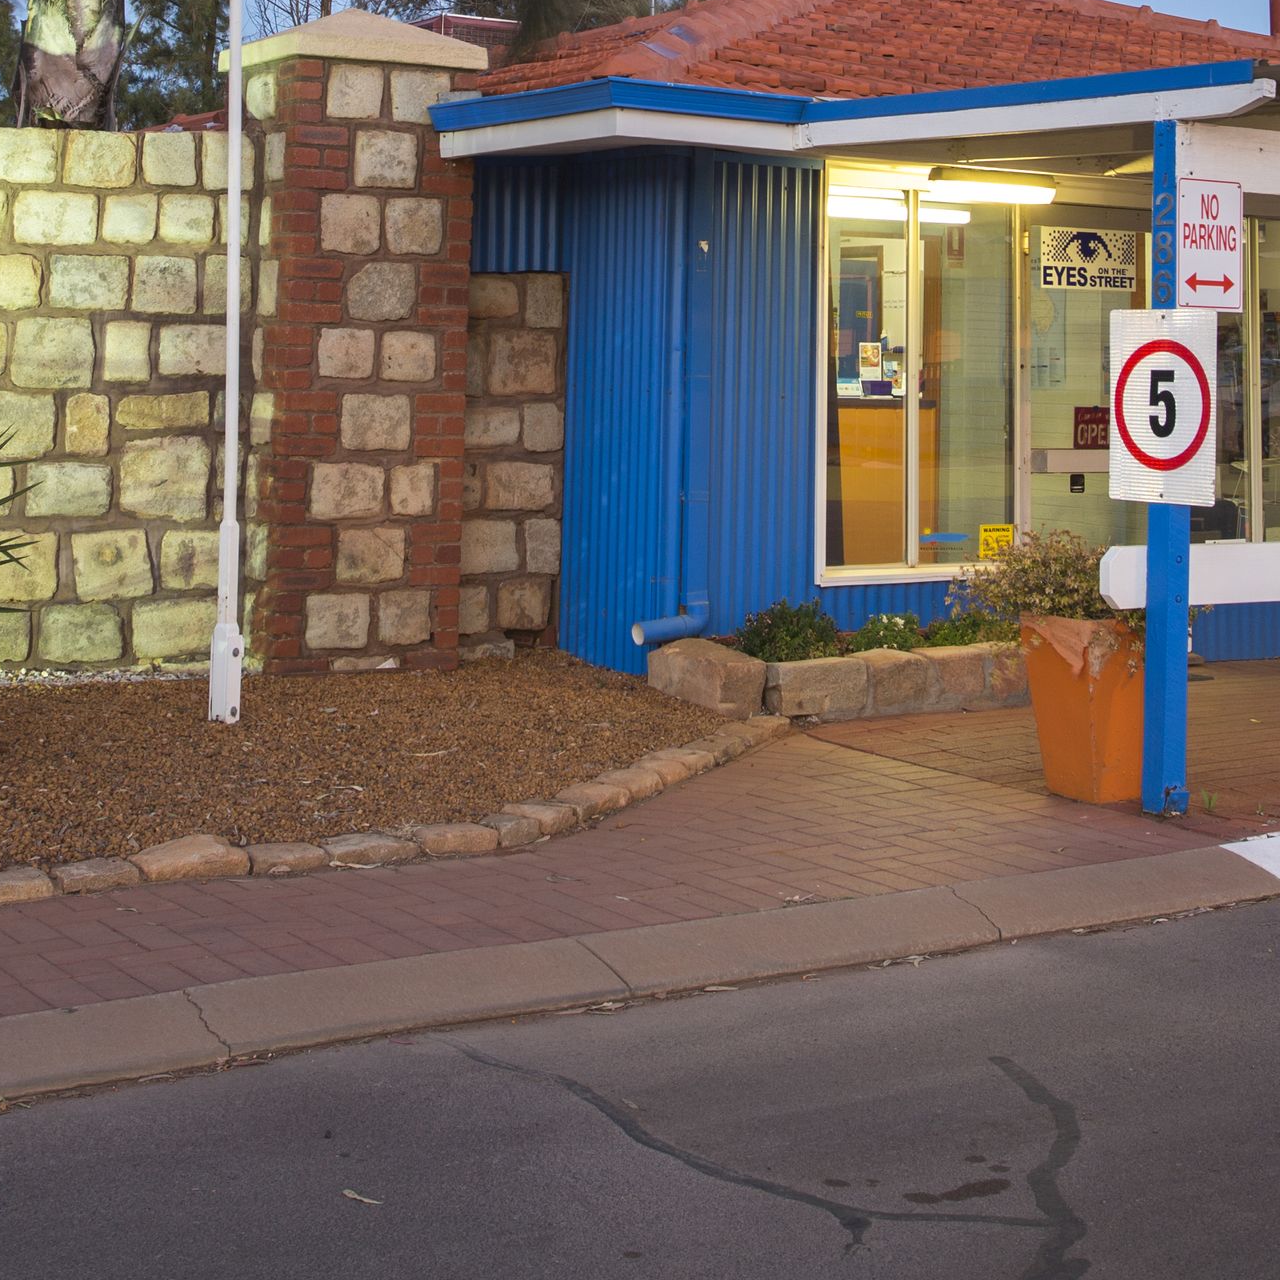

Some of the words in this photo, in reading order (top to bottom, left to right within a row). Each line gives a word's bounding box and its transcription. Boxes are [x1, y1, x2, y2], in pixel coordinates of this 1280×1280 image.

[1201, 194, 1219, 220] NO
[1183, 223, 1236, 252] PARKING
[1043, 265, 1088, 286] EYES
[1098, 267, 1109, 275] ON
[1089, 275, 1135, 288] STREET
[1148, 369, 1176, 438] 5
